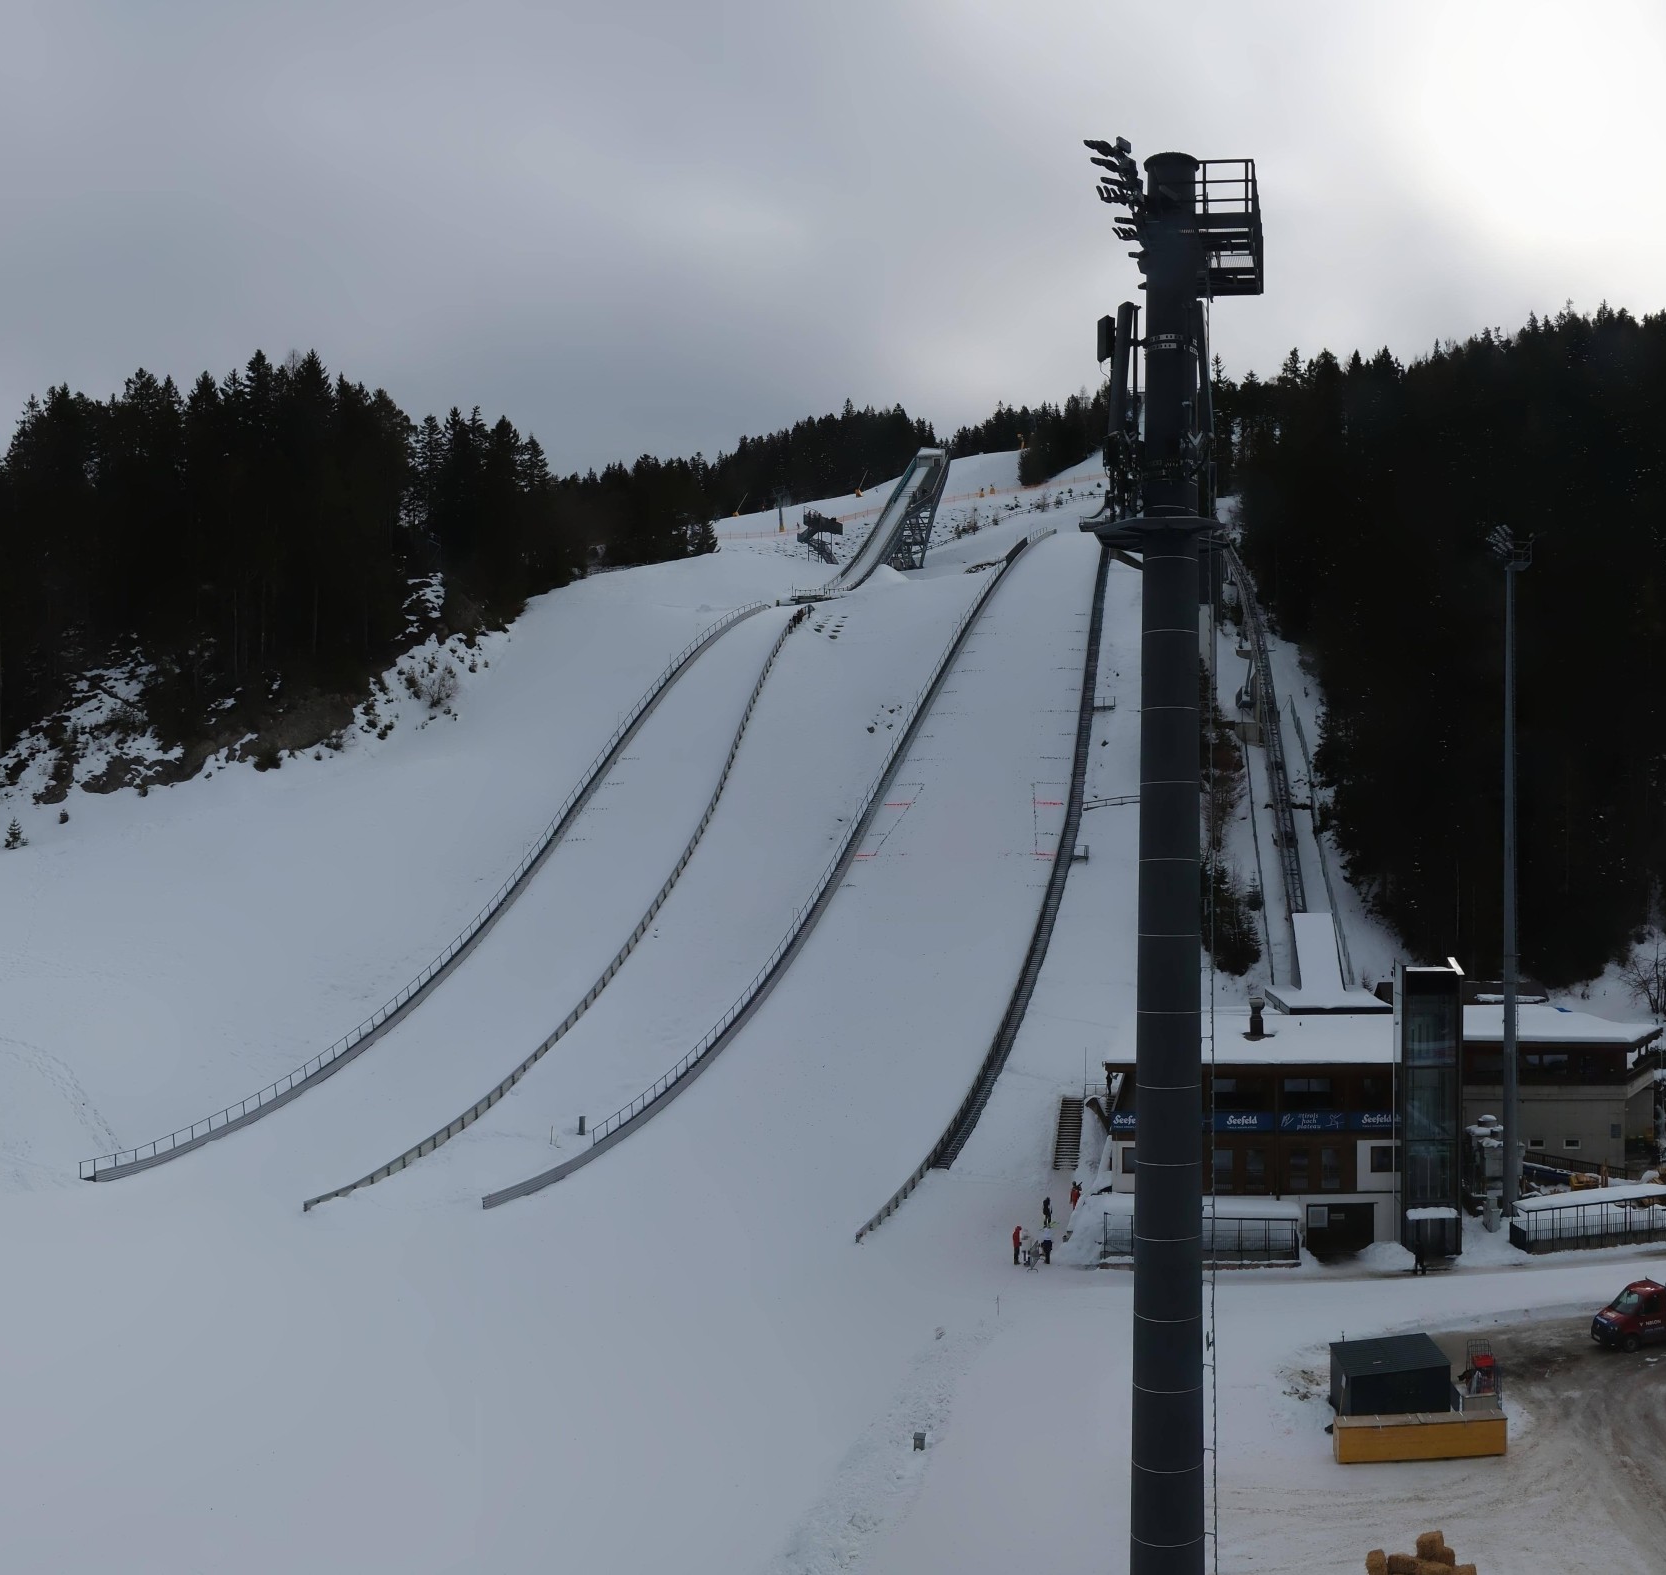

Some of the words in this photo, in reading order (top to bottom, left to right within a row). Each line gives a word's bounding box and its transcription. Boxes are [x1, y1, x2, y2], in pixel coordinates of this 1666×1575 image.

[1113, 1114, 1136, 1124] Seefe
[1226, 1115, 1257, 1125] Seefeld
[1362, 1114, 1392, 1124] Seefeld
